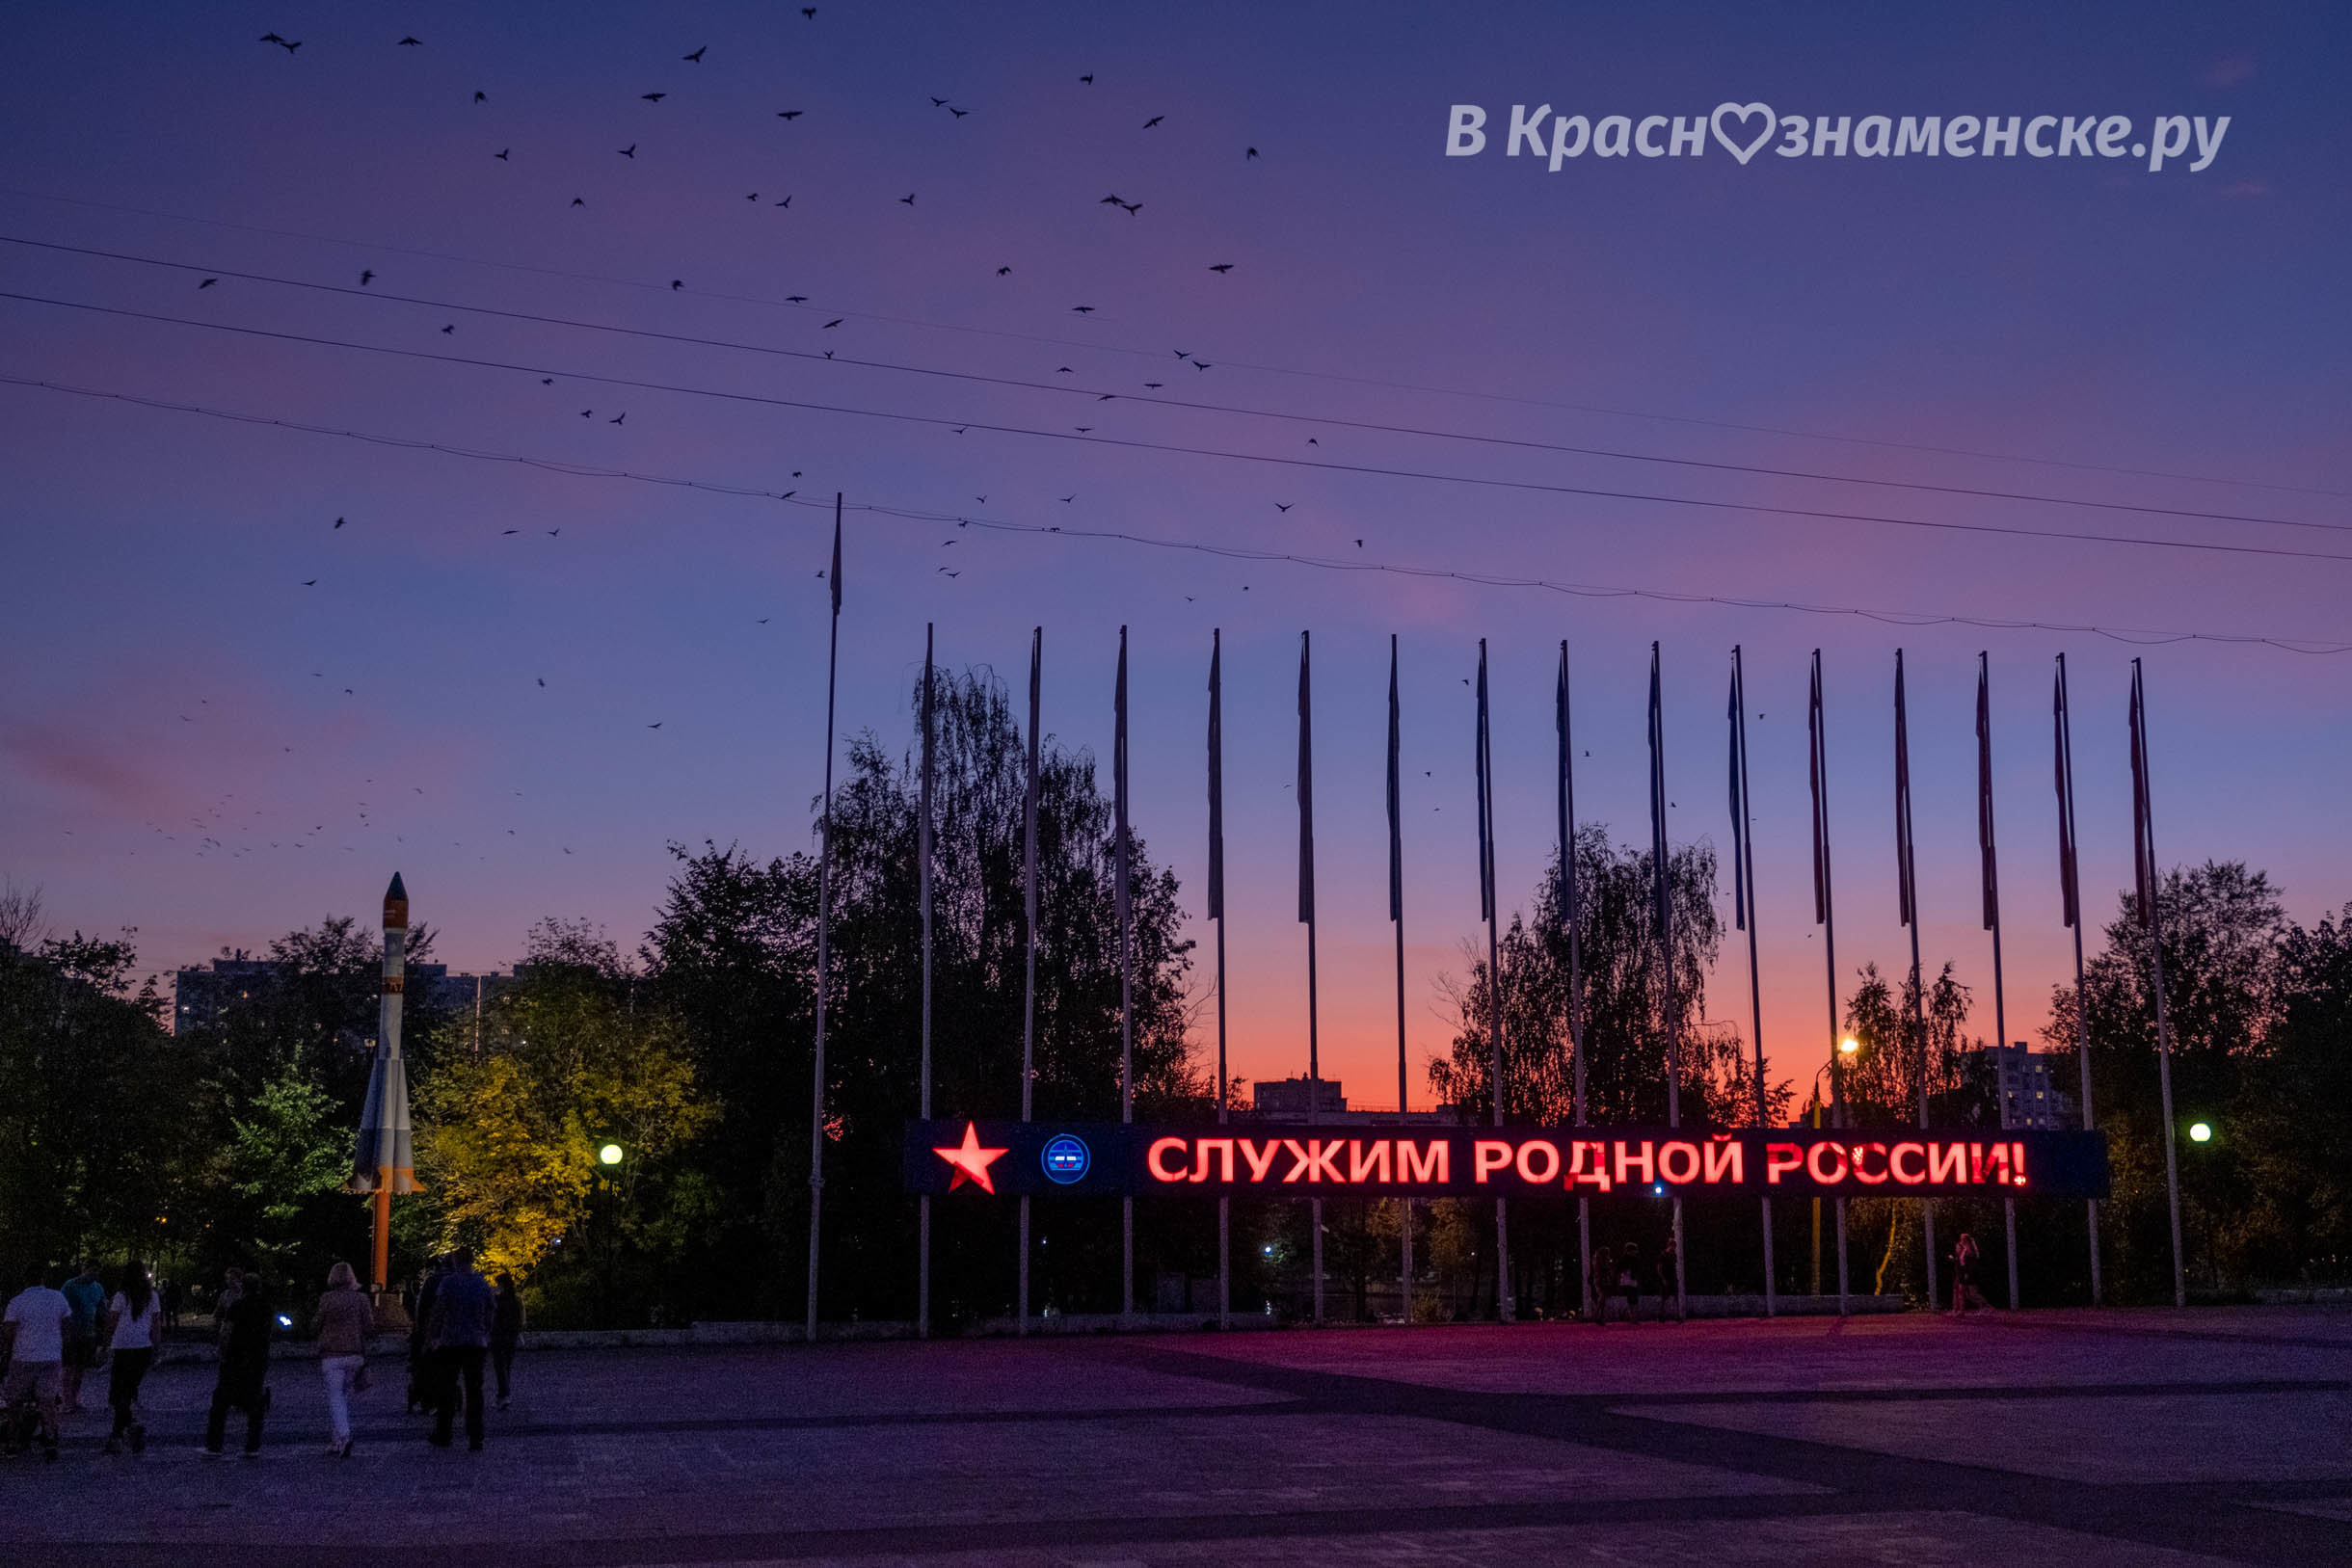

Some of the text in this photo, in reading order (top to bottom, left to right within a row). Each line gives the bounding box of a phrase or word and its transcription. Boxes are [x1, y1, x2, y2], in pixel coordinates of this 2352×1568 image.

[1146, 1132, 2027, 1193] СЛУЖИМ РОДНОЙ РОССИИ!
